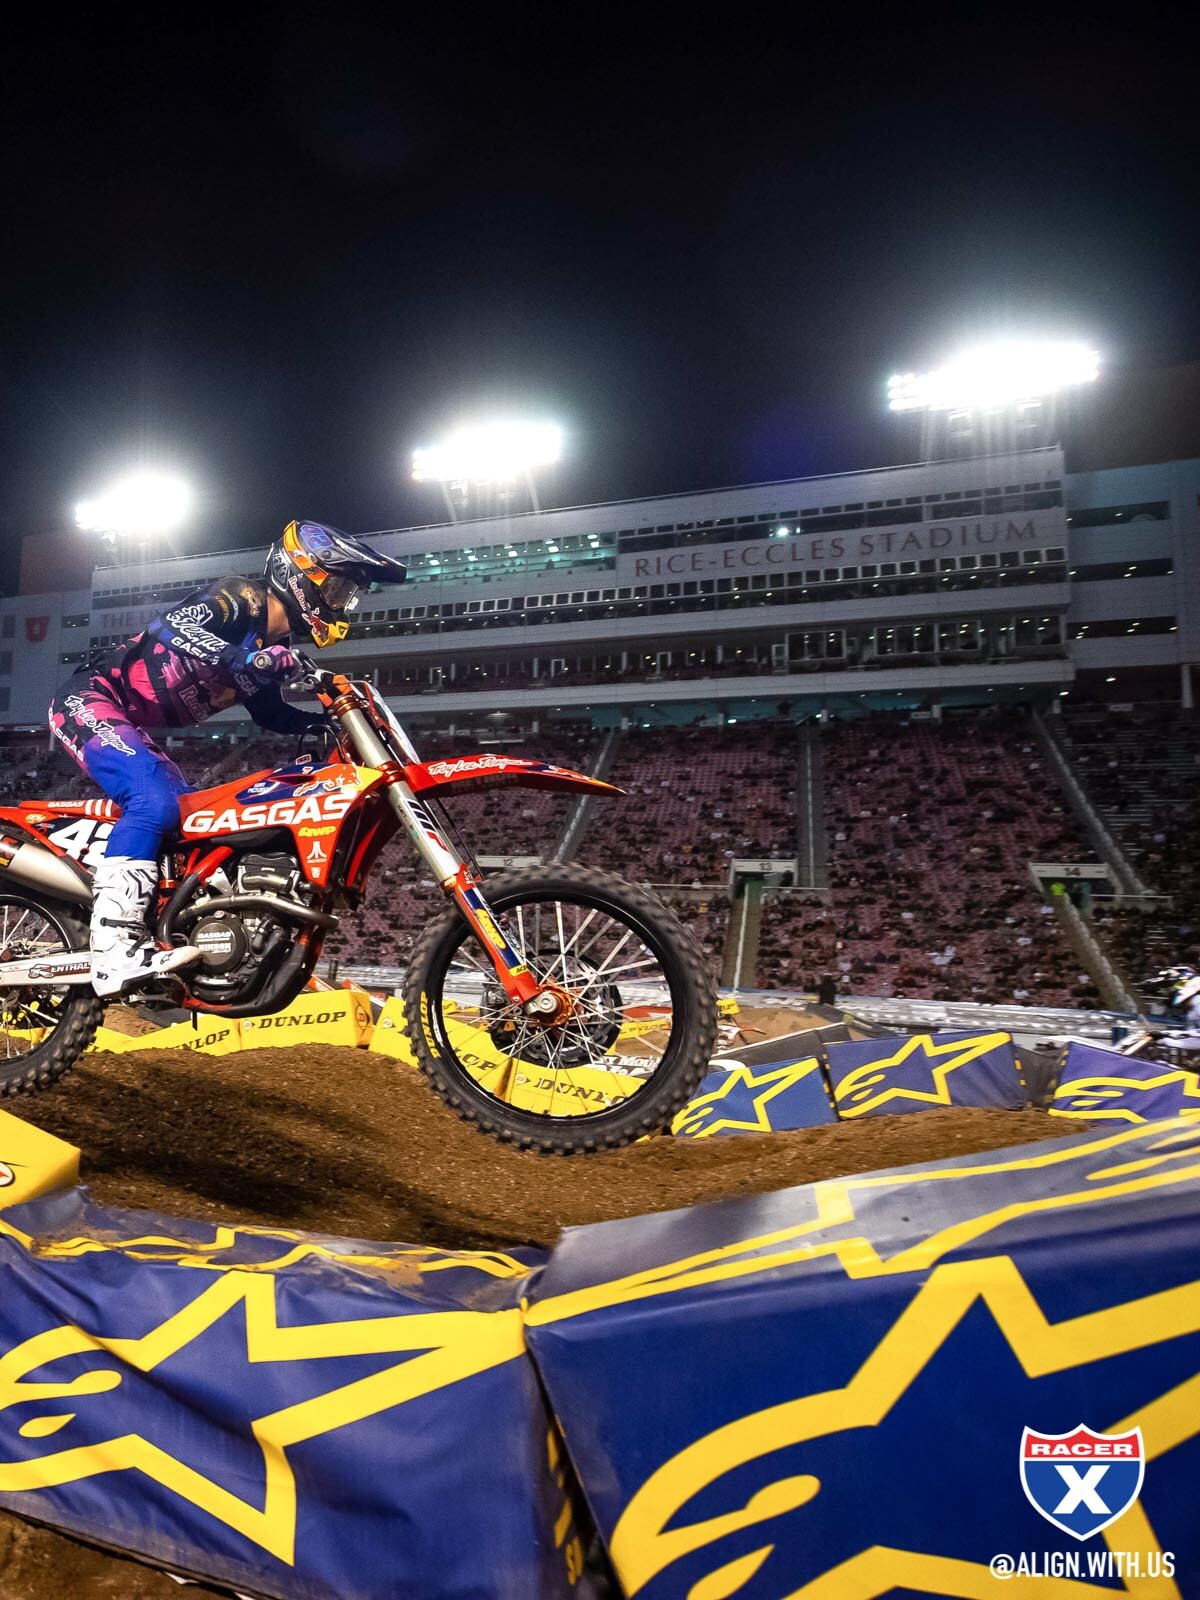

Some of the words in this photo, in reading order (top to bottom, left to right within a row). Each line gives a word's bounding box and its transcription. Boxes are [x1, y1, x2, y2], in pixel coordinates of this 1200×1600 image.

[634, 536, 846, 577] RICE-ECCLES
[860, 520, 1037, 556] STADIUM
[183, 790, 358, 834] GASGAS
[1063, 866, 1081, 877] 14
[258, 1011, 347, 1029] DUNLOP
